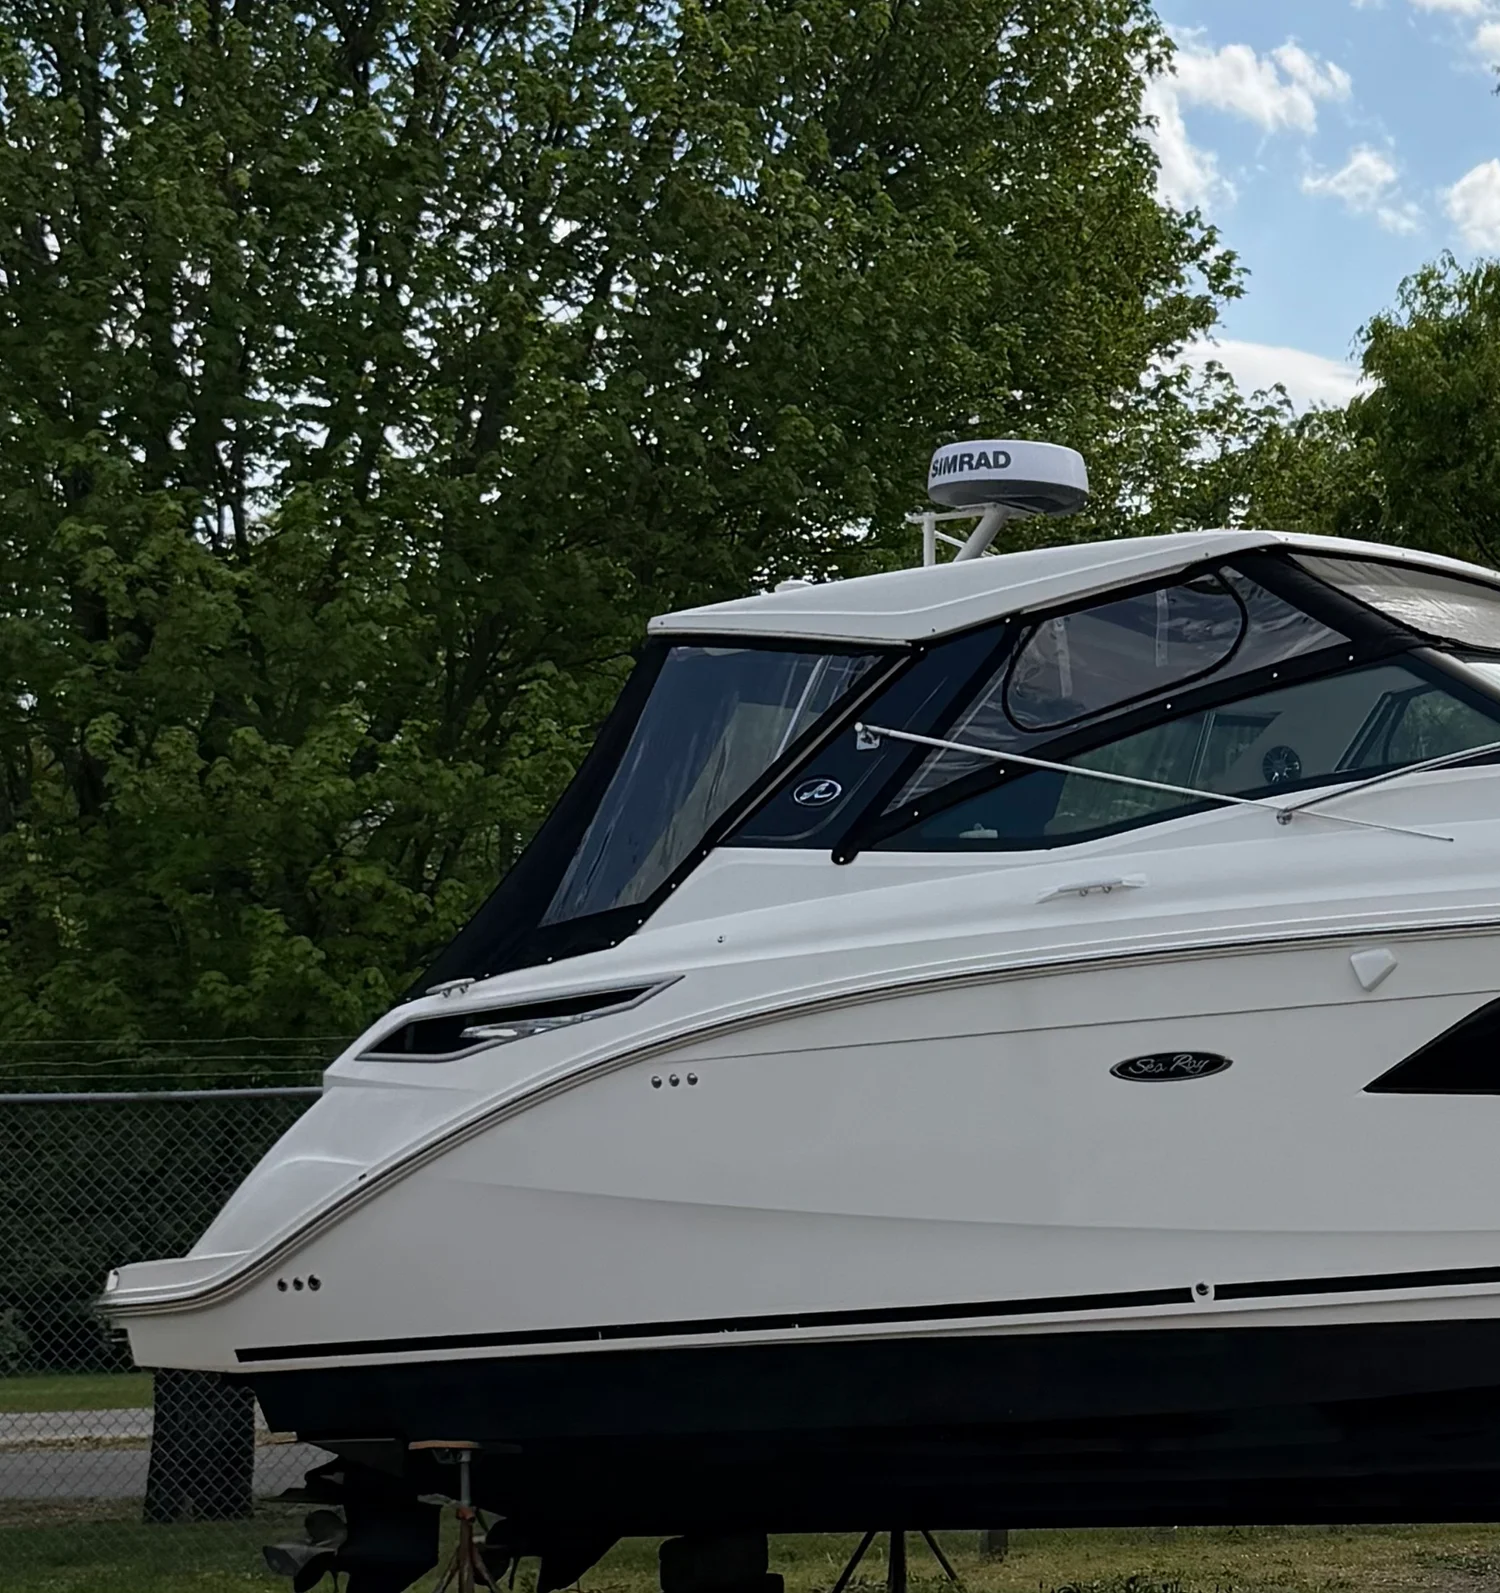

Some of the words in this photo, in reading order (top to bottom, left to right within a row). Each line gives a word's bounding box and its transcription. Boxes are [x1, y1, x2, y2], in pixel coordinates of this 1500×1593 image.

[931, 451, 1012, 478] SIMRAD
[1128, 1058, 1168, 1074] Sea
[1169, 1053, 1210, 1075] Ray
